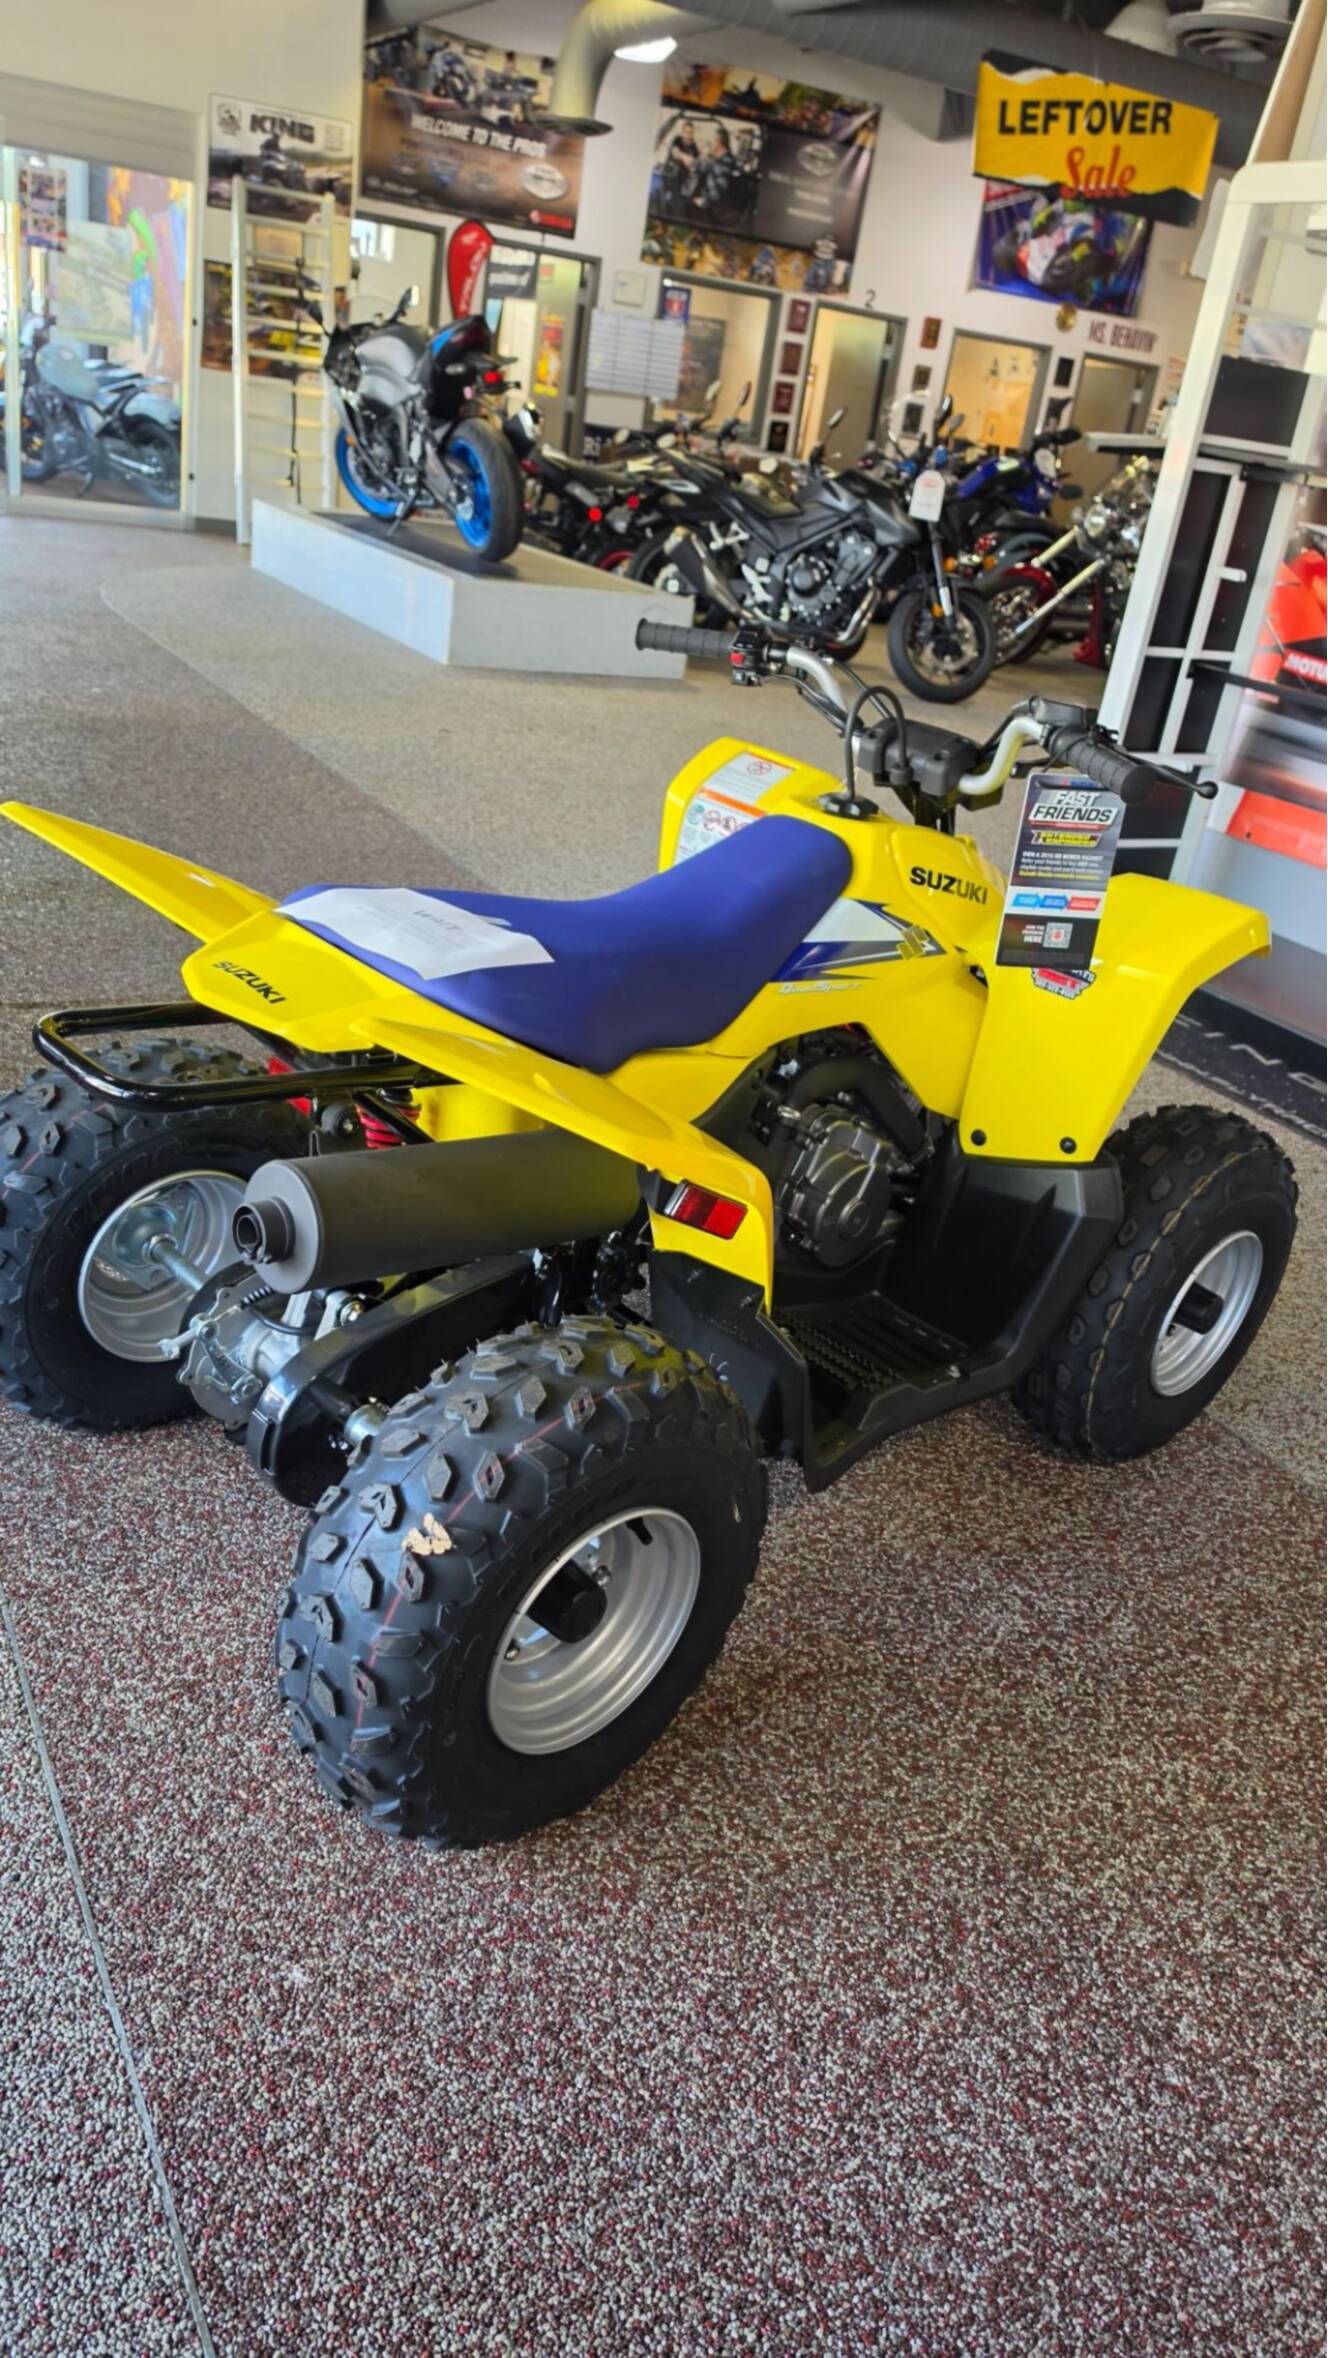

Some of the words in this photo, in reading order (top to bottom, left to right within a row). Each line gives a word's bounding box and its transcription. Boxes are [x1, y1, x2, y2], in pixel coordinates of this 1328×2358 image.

[411, 114, 471, 142] WELCOME
[472, 126, 489, 145] TO
[489, 131, 513, 151] THE
[998, 100, 1173, 136] LEFTOVER
[1060, 145, 1137, 198] Sale
[865, 288, 876, 309] 2
[1033, 805, 1113, 822] FRIENDS
[1052, 790, 1101, 807] FAST
[910, 866, 988, 904] SUZUKI
[212, 961, 286, 1004] SUZUKI
